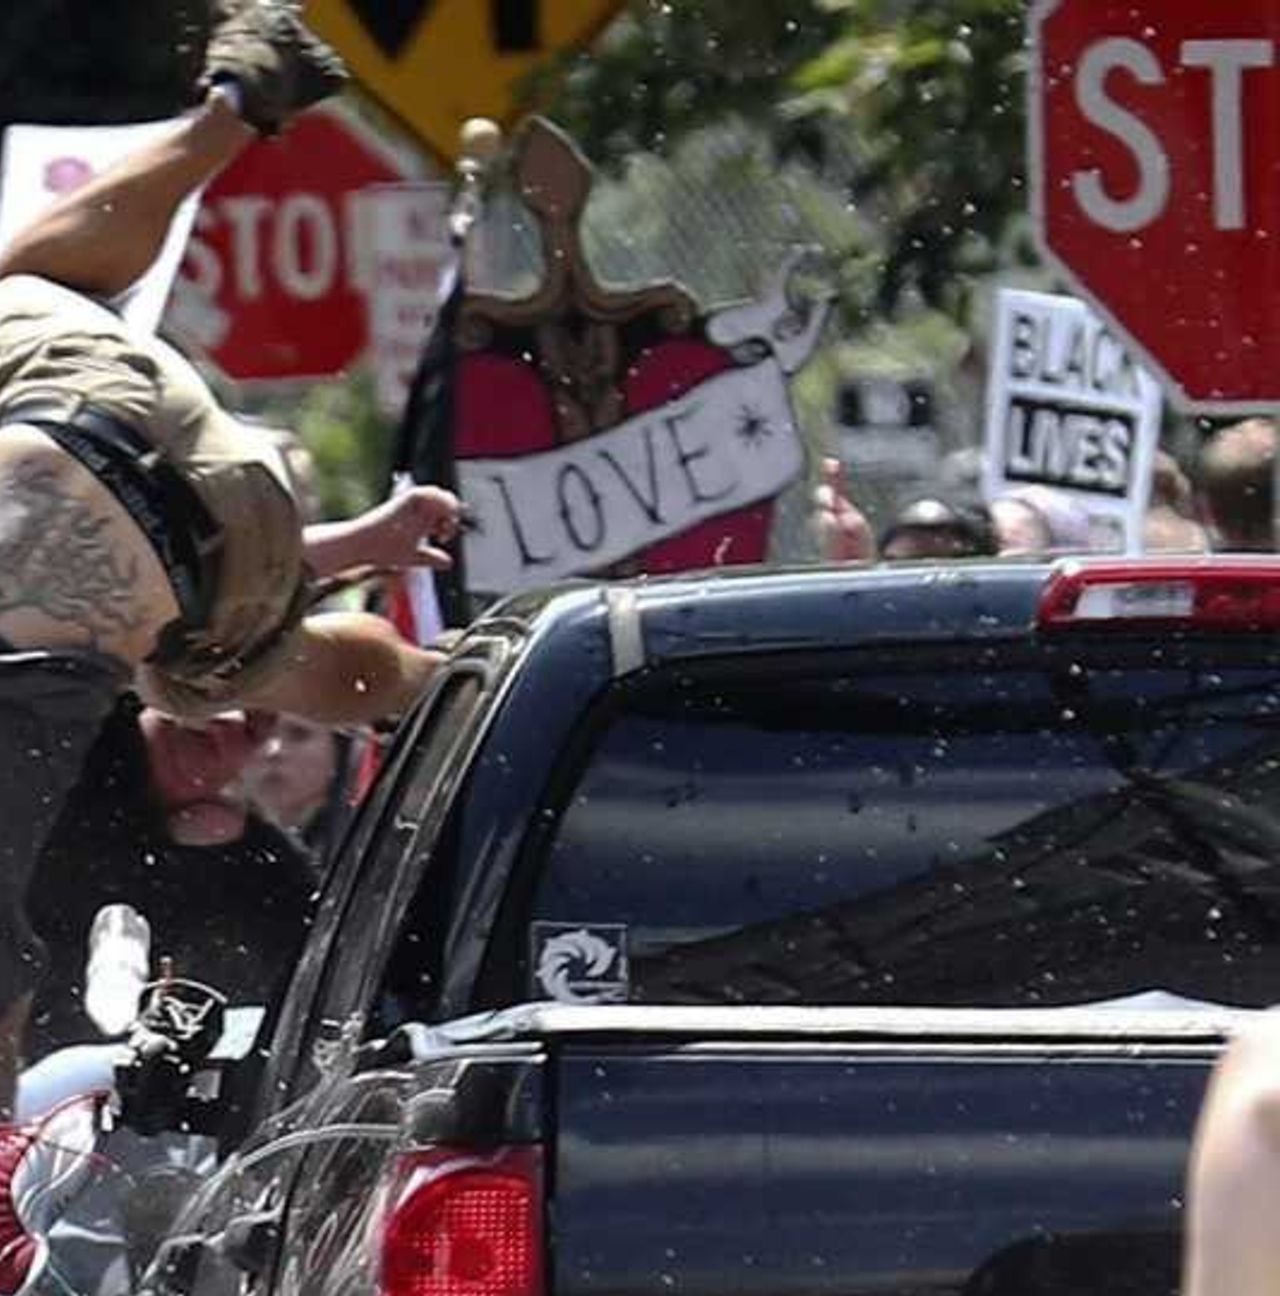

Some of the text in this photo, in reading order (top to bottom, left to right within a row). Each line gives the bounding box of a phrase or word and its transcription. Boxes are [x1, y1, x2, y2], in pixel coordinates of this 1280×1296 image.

[1072, 36, 1274, 232] ST
[491, 404, 739, 566] LOVE
[1009, 404, 1131, 489] LIVES
